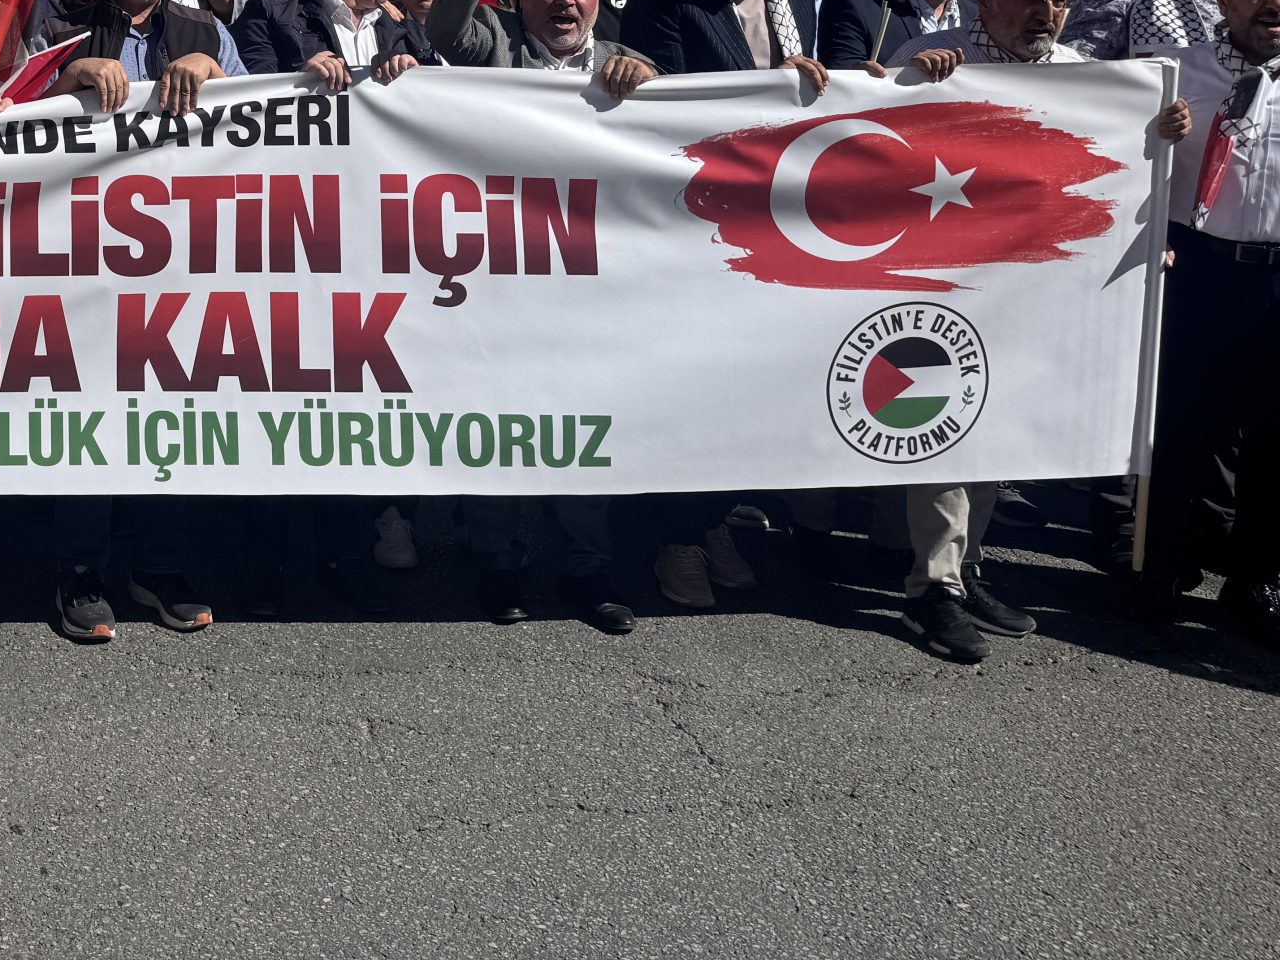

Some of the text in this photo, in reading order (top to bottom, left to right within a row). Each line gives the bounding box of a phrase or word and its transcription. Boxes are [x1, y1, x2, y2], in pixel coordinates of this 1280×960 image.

[116, 291, 413, 393] KALK
[835, 309, 980, 383] FİLİSTİN'E DESTEK
[126, 398, 240, 482] İÇİN
[258, 398, 612, 467] YÜRÜYORUZ
[848, 415, 961, 457] PLATFORMU
